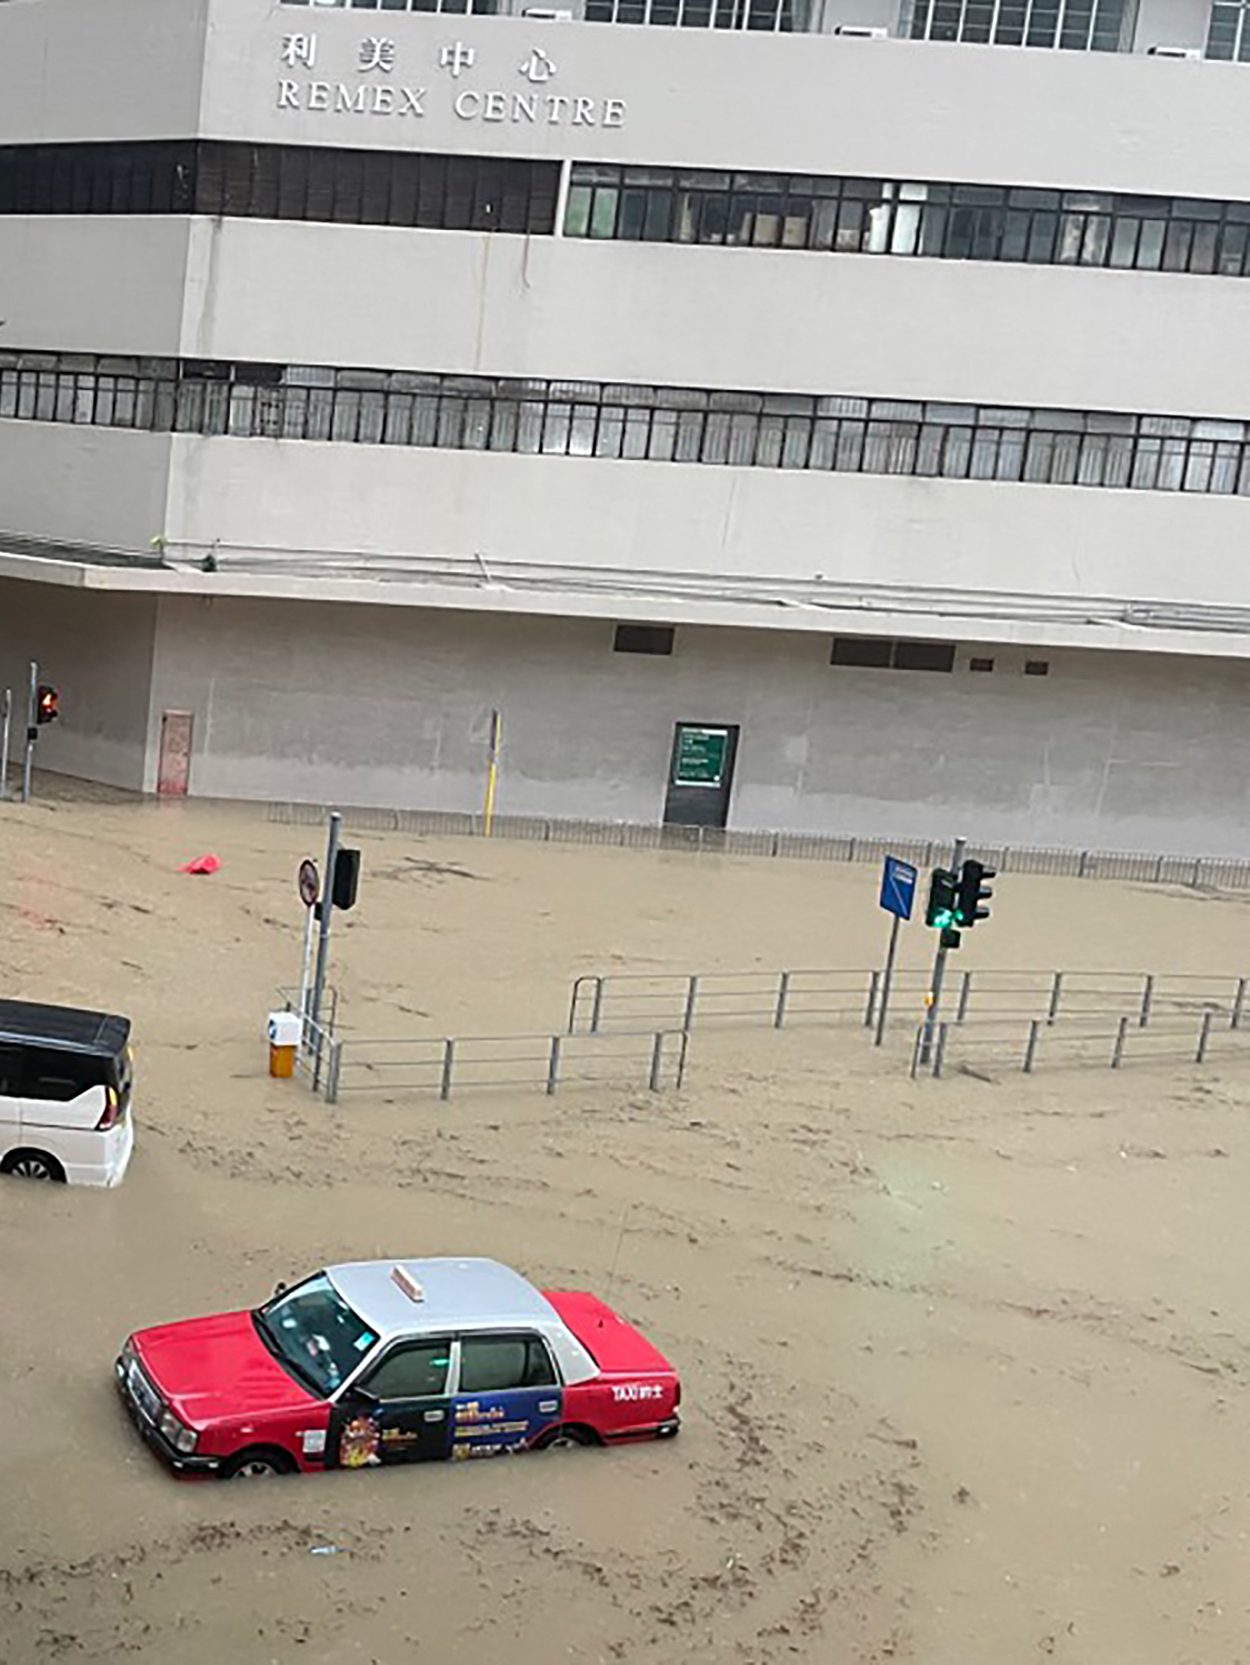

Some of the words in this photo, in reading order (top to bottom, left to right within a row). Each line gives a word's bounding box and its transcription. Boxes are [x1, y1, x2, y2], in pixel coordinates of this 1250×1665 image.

[281, 33, 557, 82] 利美中心
[277, 81, 427, 117] REMEX
[455, 90, 627, 127] CENTRE
